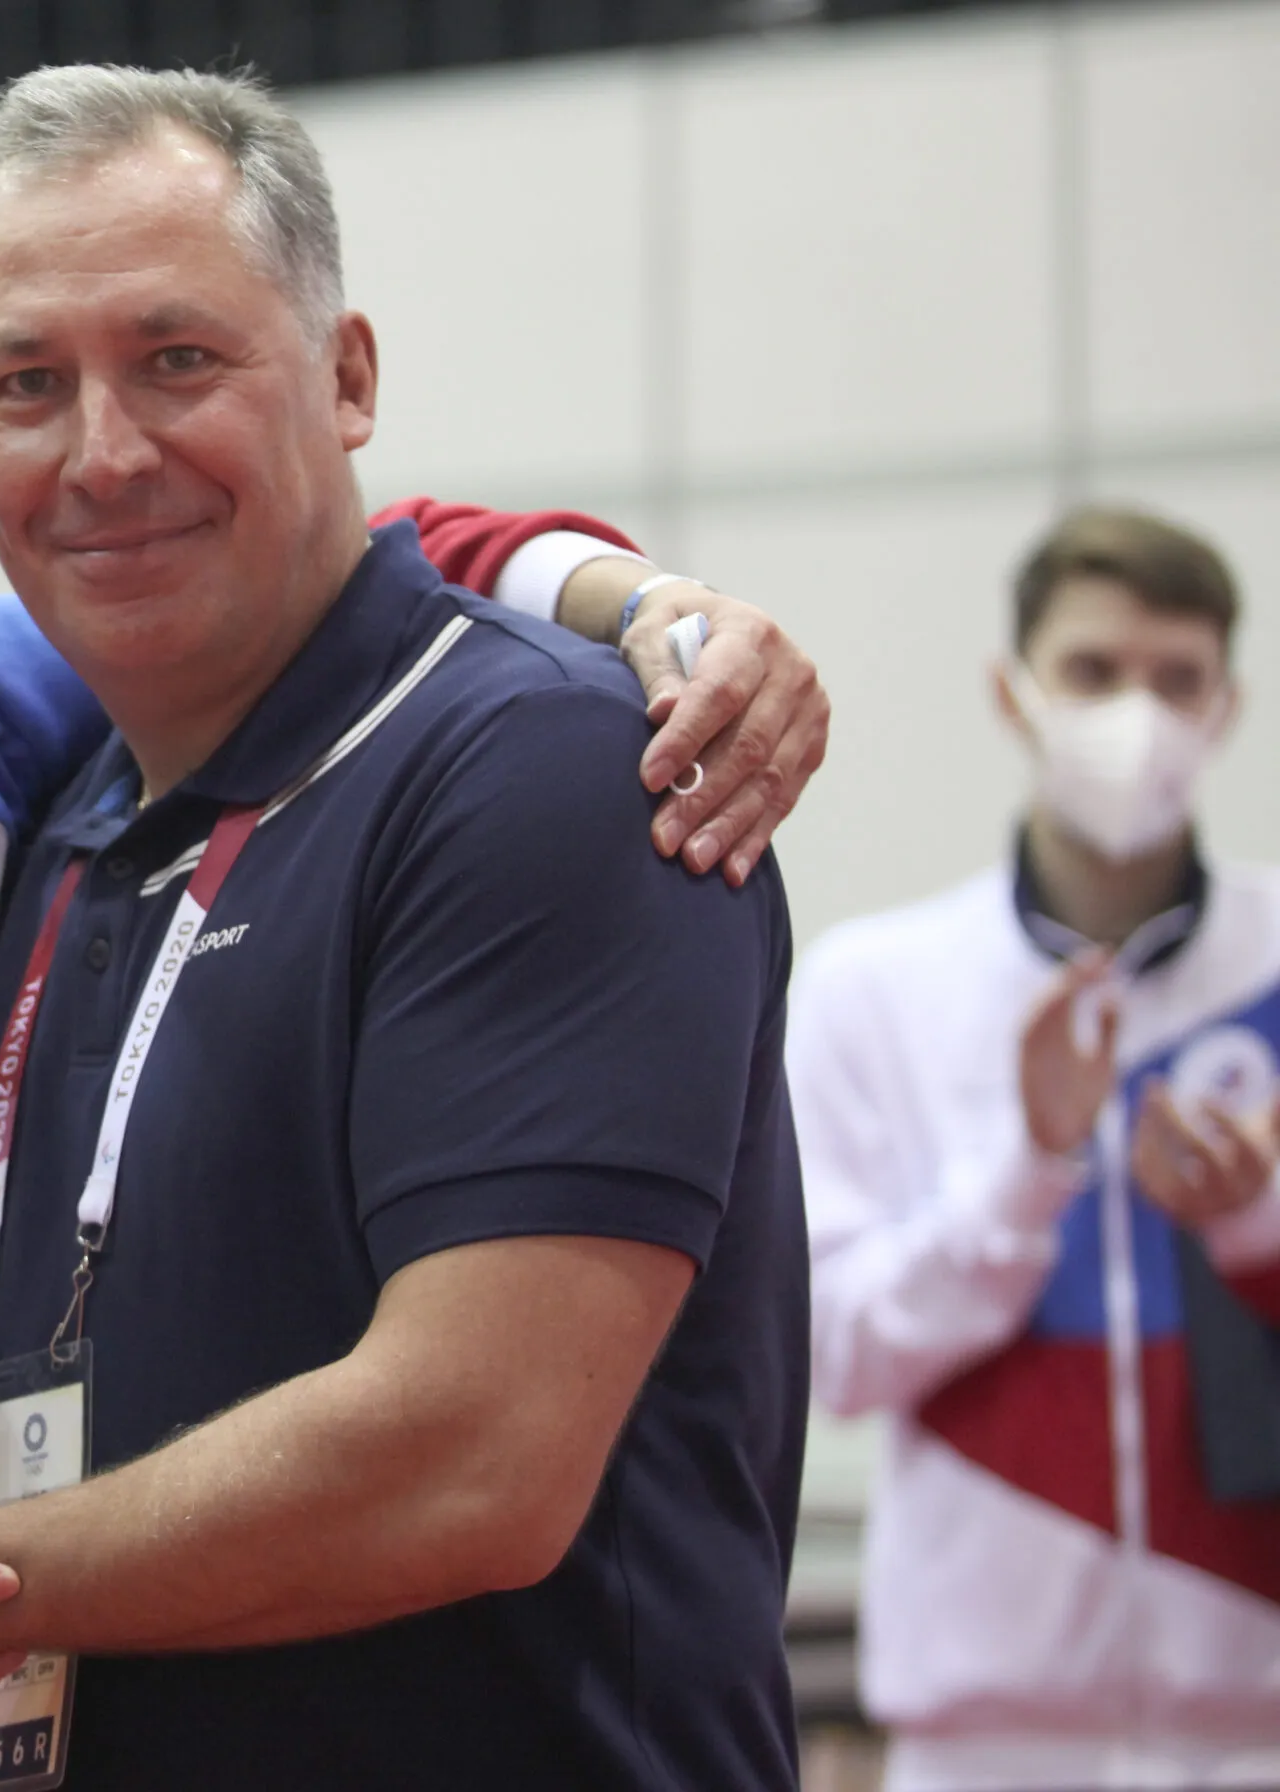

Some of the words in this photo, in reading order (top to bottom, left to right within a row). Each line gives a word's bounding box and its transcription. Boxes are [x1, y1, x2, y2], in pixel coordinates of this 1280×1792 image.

[1, 976, 44, 1075] TOKYO
[115, 1002, 161, 1103] TOKYO
[156, 920, 195, 994] 2020
